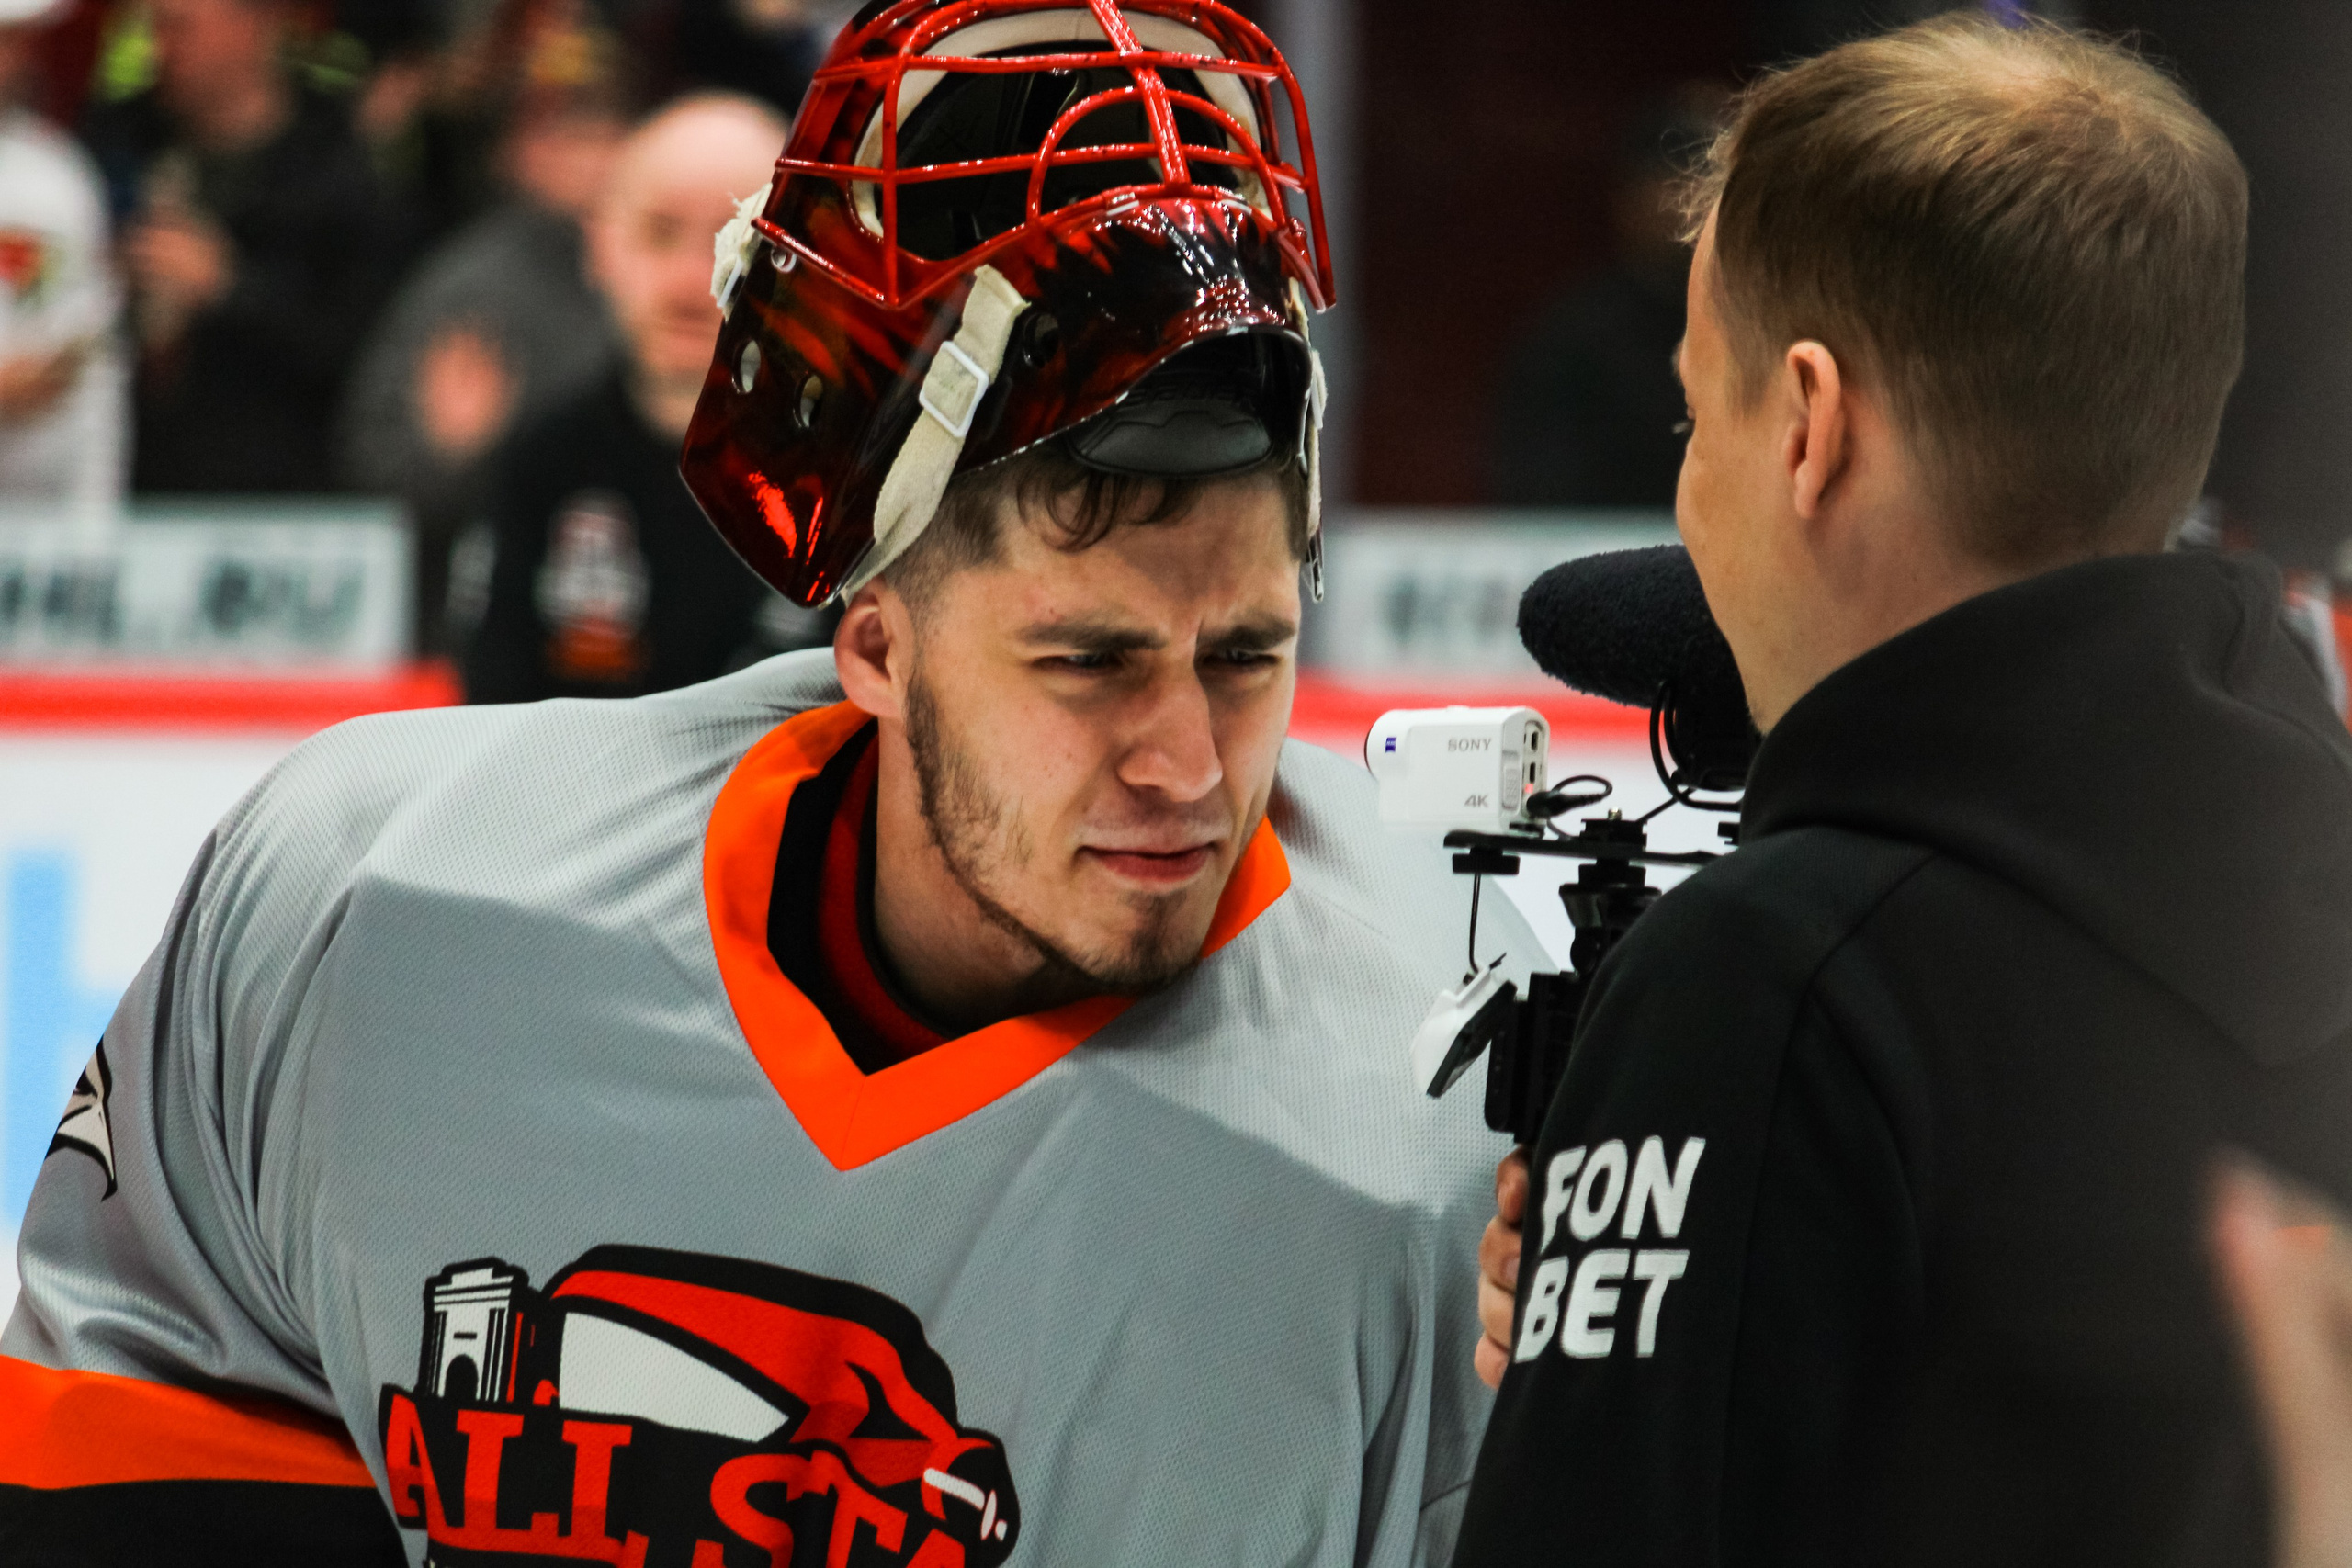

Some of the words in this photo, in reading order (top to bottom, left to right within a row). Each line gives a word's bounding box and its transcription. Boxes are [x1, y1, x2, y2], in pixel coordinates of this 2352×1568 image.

[1448, 738, 1492, 752] SONY
[1464, 795, 1489, 808] 4K
[1540, 1135, 1706, 1255] FON
[1514, 1248, 1690, 1363] BET
[385, 1393, 649, 1568] ALL
